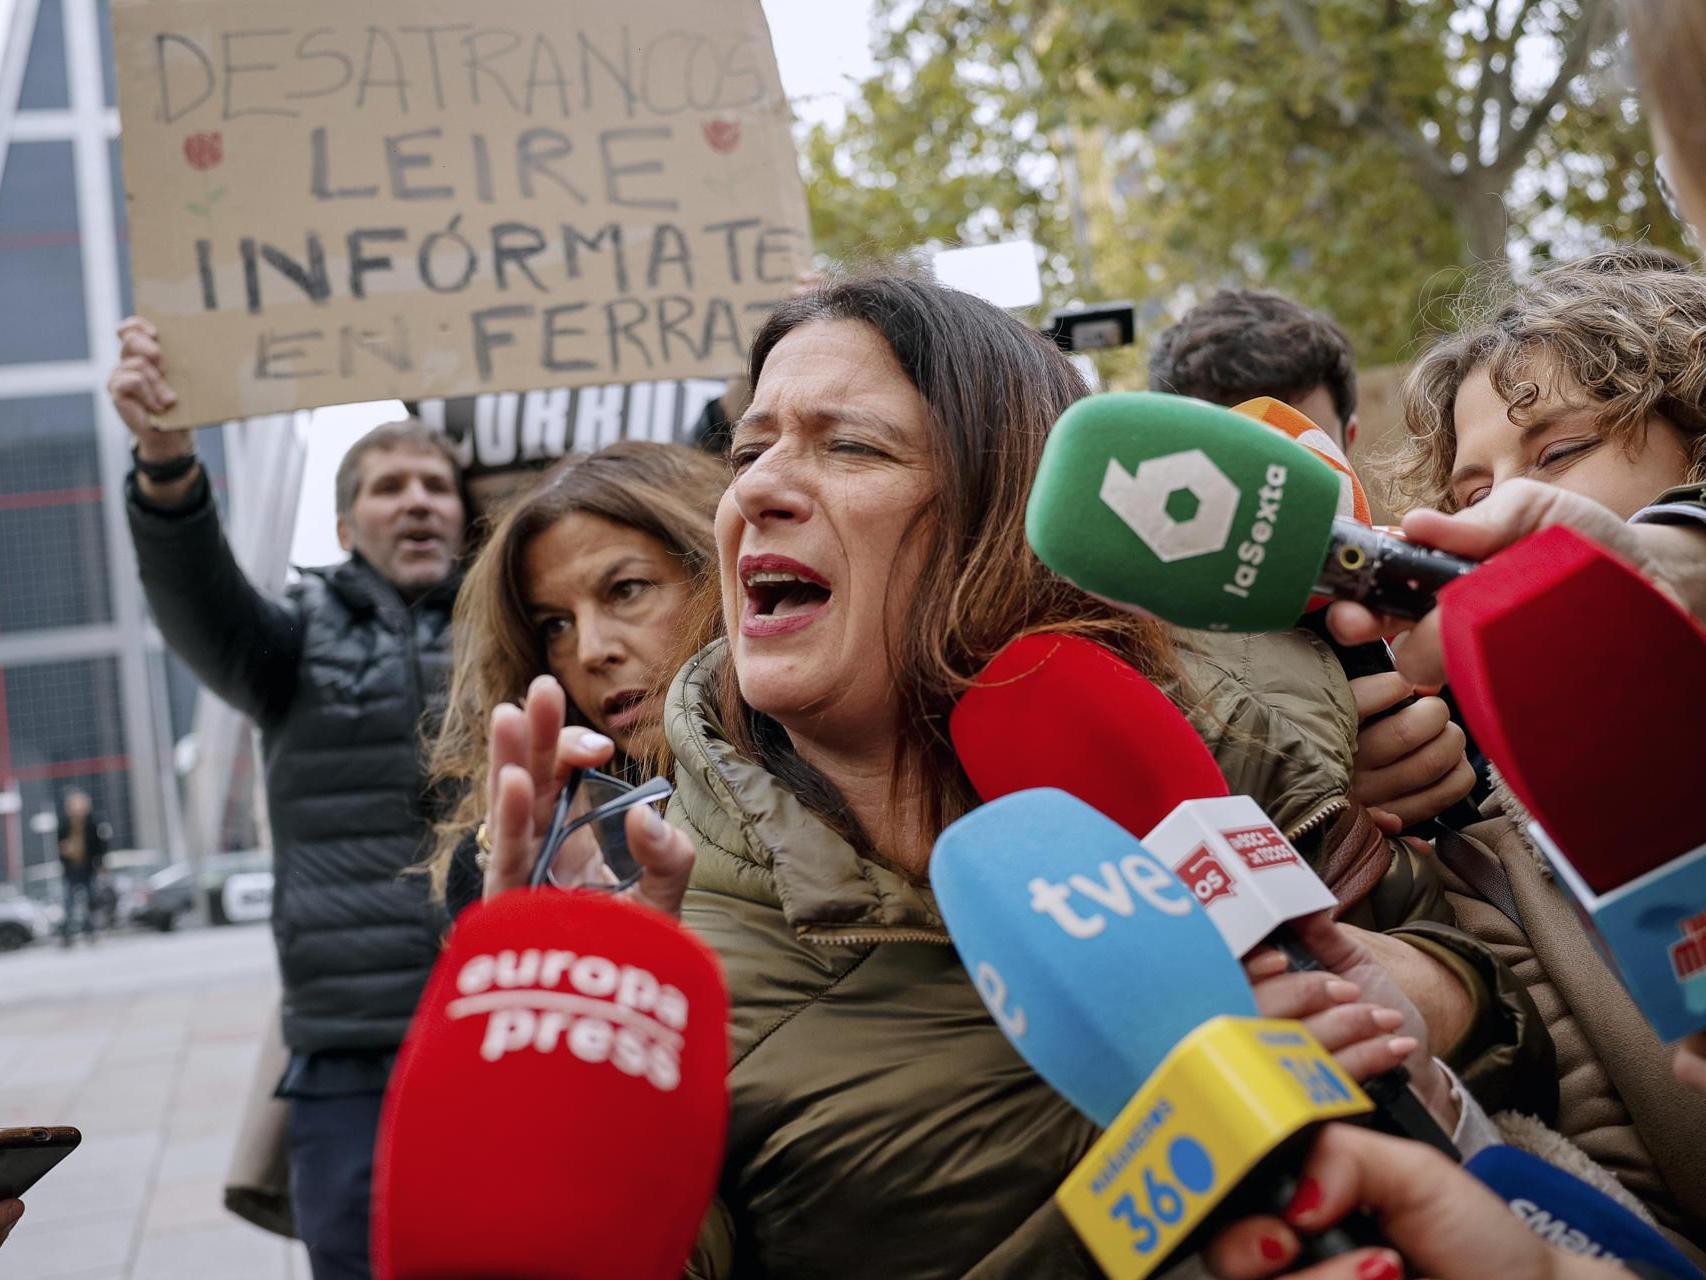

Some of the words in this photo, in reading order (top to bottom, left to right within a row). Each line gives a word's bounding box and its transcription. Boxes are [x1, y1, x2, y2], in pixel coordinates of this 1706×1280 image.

[154, 23, 769, 123] DESATRANCOS
[310, 126, 679, 211] LEIRE
[195, 213, 803, 313] INFÓRMATE
[253, 318, 414, 381] EN
[1223, 463, 1289, 598] laSexta
[1027, 853, 1193, 939] tve
[456, 948, 689, 1031] europa
[480, 1008, 683, 1091] press
[1109, 1134, 1216, 1254] 360
